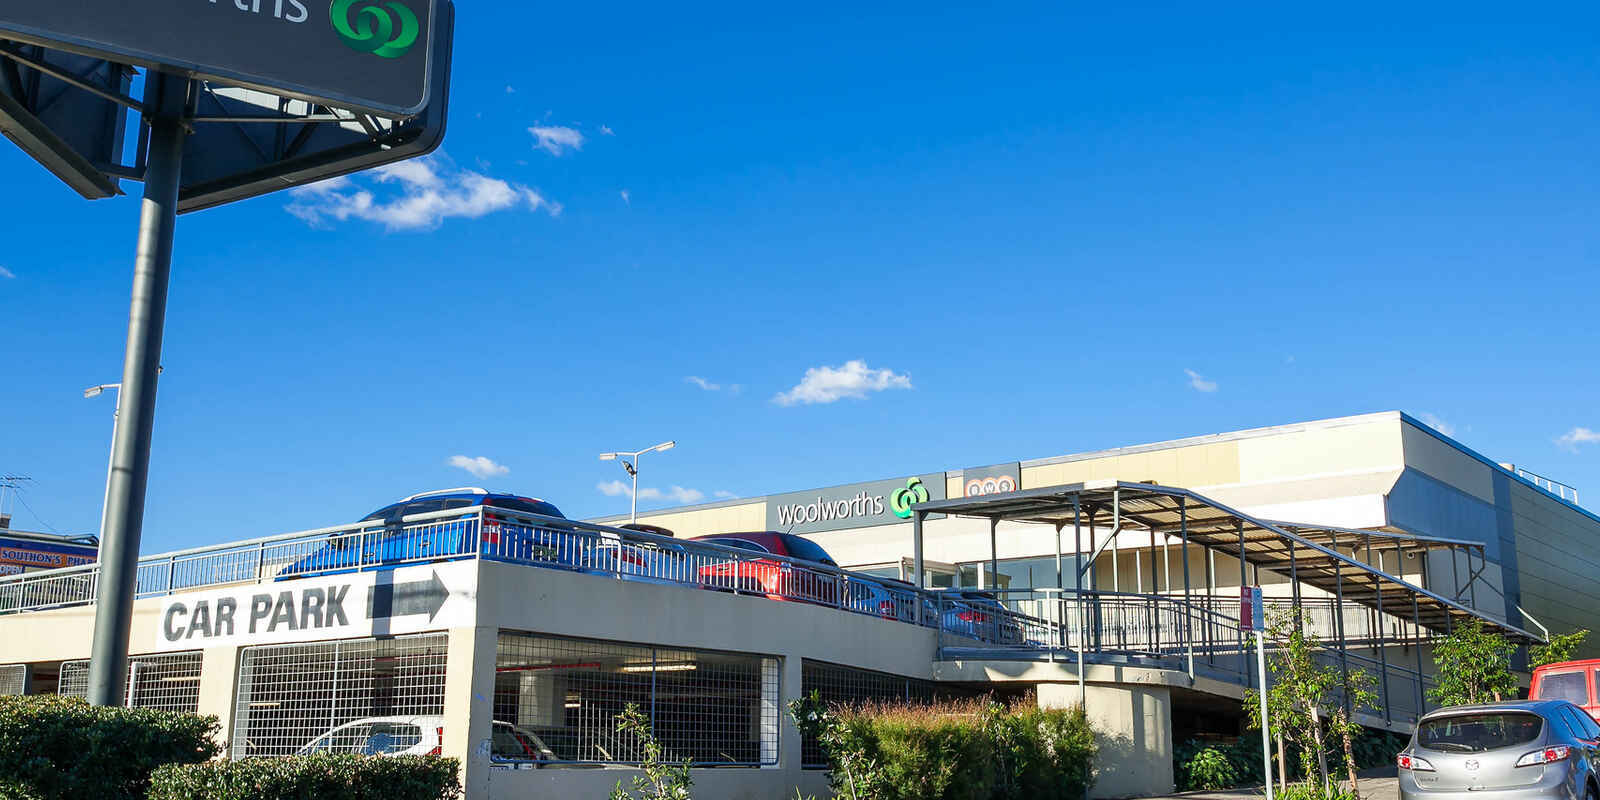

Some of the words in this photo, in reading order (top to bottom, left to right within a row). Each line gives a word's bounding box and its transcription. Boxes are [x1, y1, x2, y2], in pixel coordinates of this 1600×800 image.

[1, 550, 62, 564] SOUTHON'S
[163, 597, 237, 642] CAR
[248, 584, 352, 634] PARK
